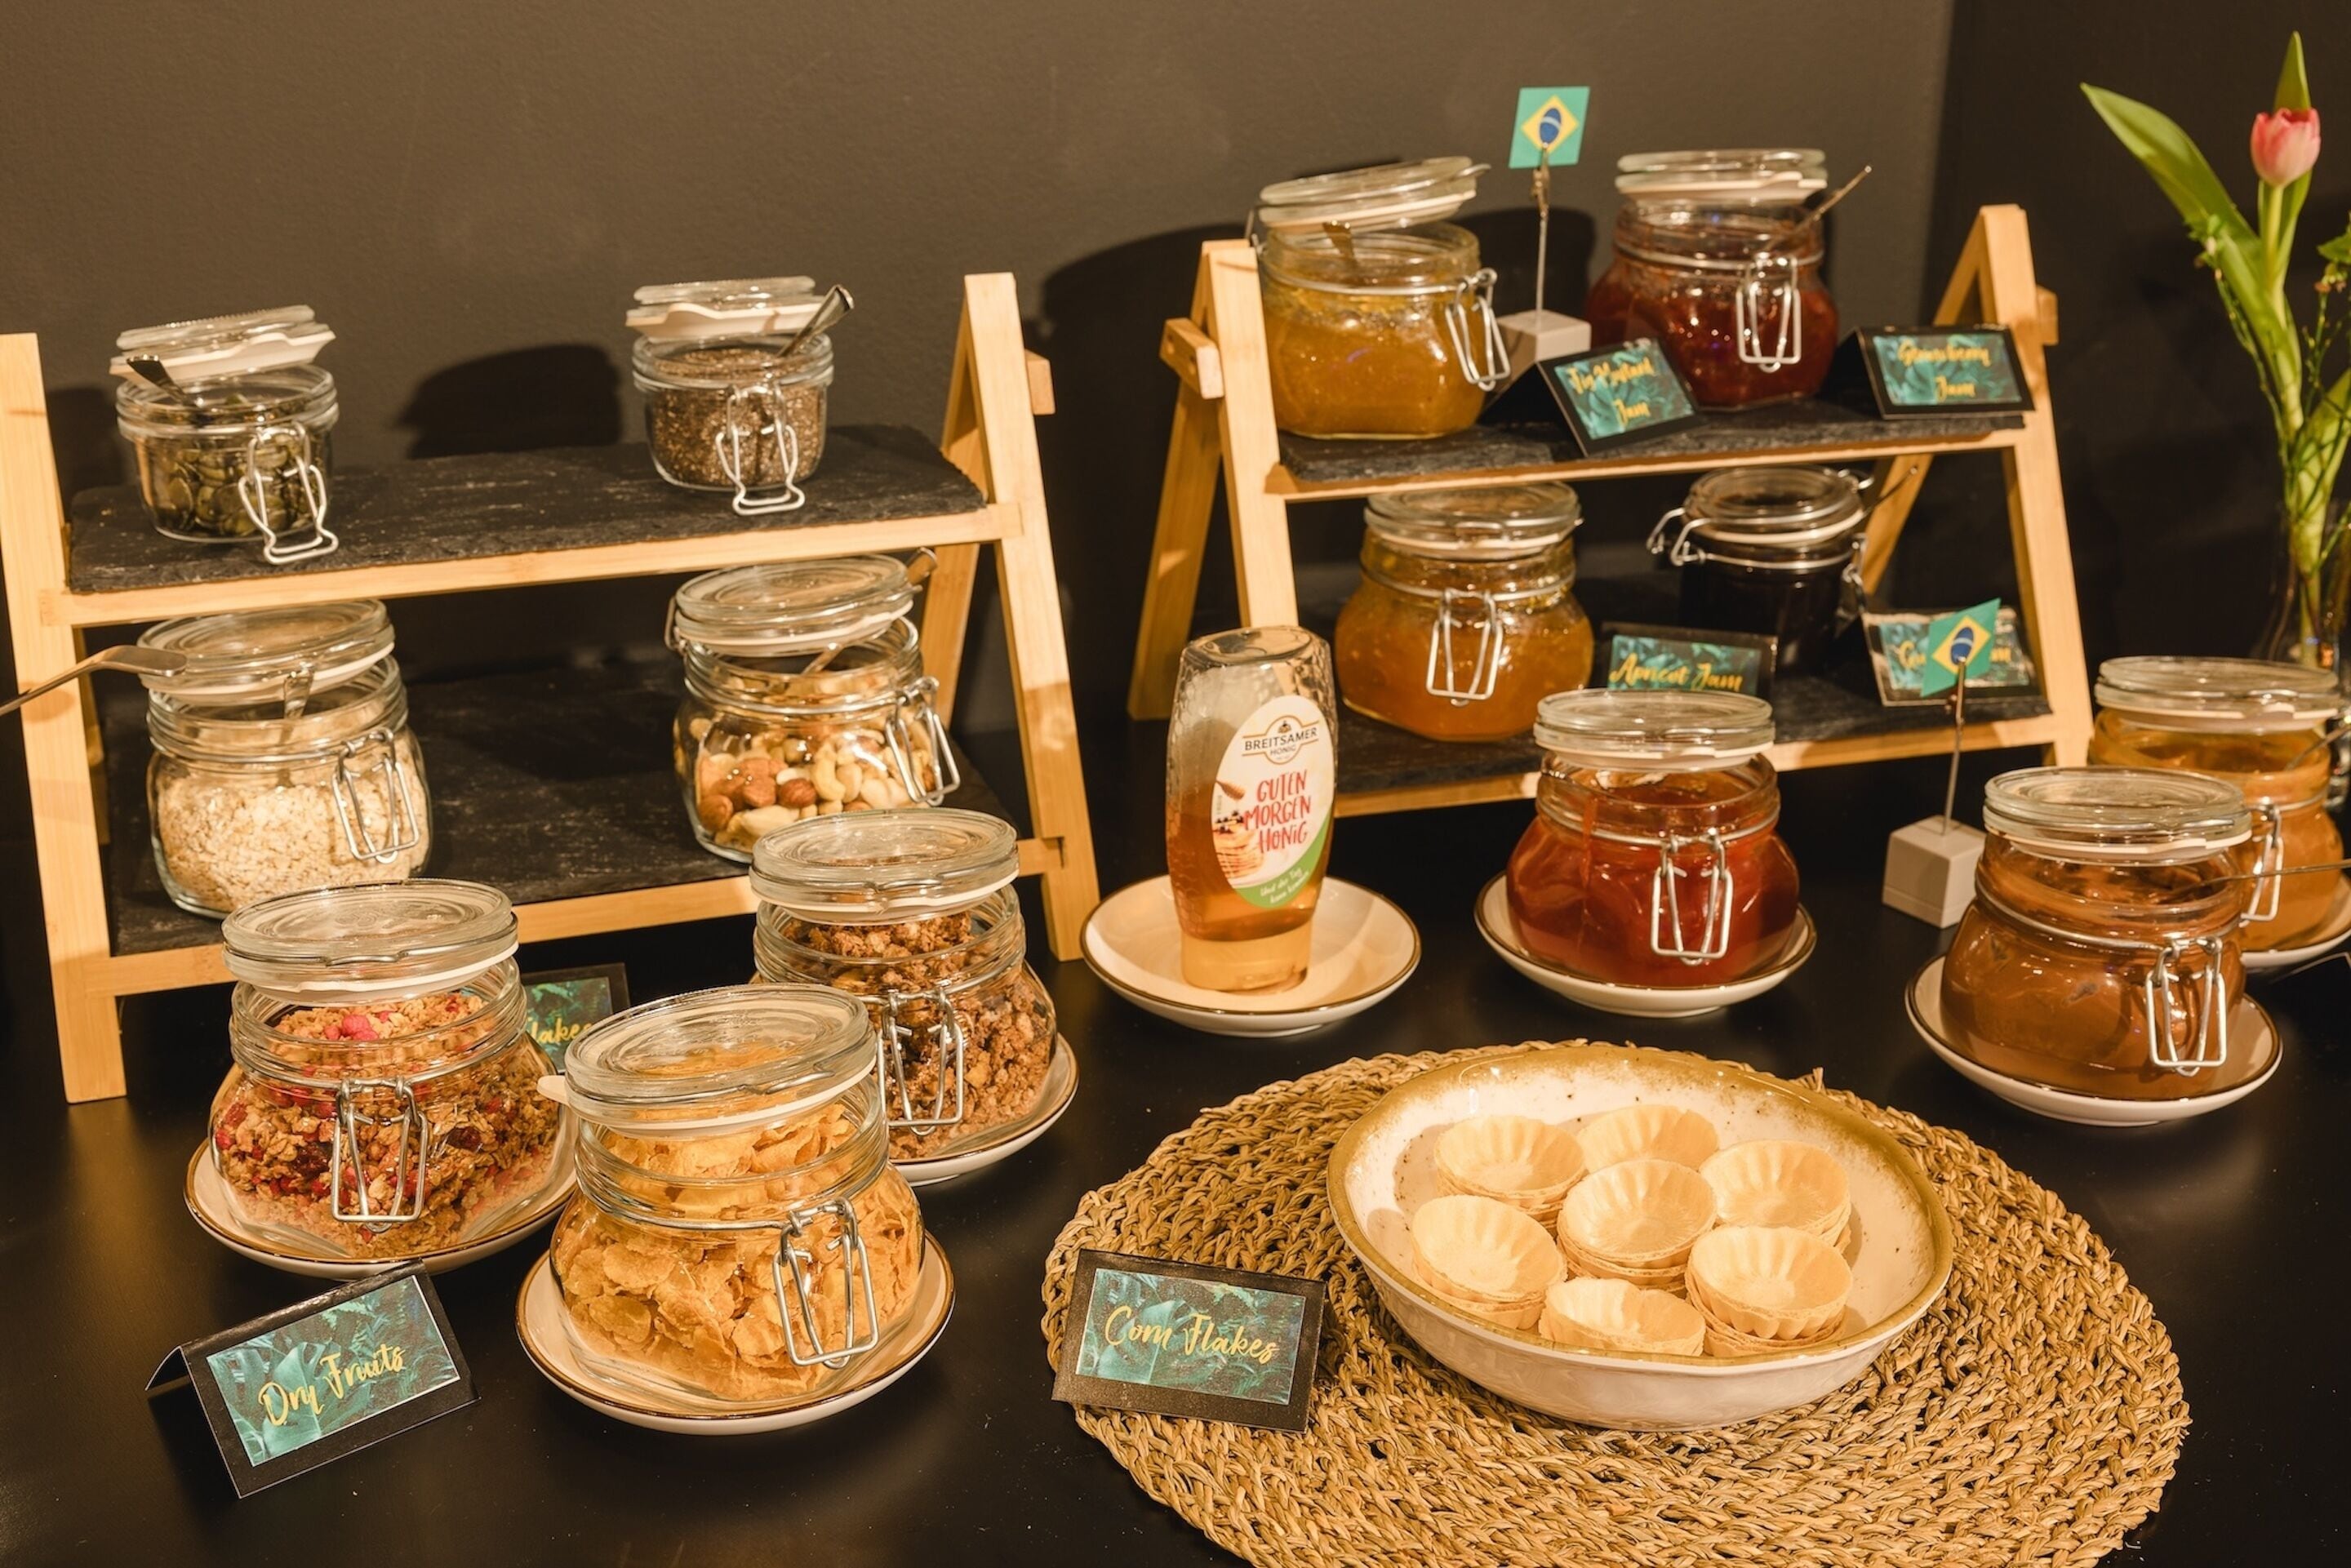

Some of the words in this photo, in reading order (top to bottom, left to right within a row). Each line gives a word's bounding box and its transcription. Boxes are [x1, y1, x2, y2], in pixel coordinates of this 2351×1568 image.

[1935, 375, 1975, 402] Jam
[1612, 398, 1651, 429] Jam
[1608, 652, 1689, 687] Apricot
[1691, 662, 1743, 691] Jam
[1245, 727, 1317, 751] BREITSAMER
[1270, 744, 1296, 756] HONIG
[1256, 770, 1308, 803] GUTEN
[1243, 796, 1312, 831] MORGEN
[1104, 1305, 1173, 1351] Corn
[1184, 1313, 1280, 1365] Flakes
[258, 1382, 325, 1426] Dry
[319, 1343, 407, 1400] Fruits
